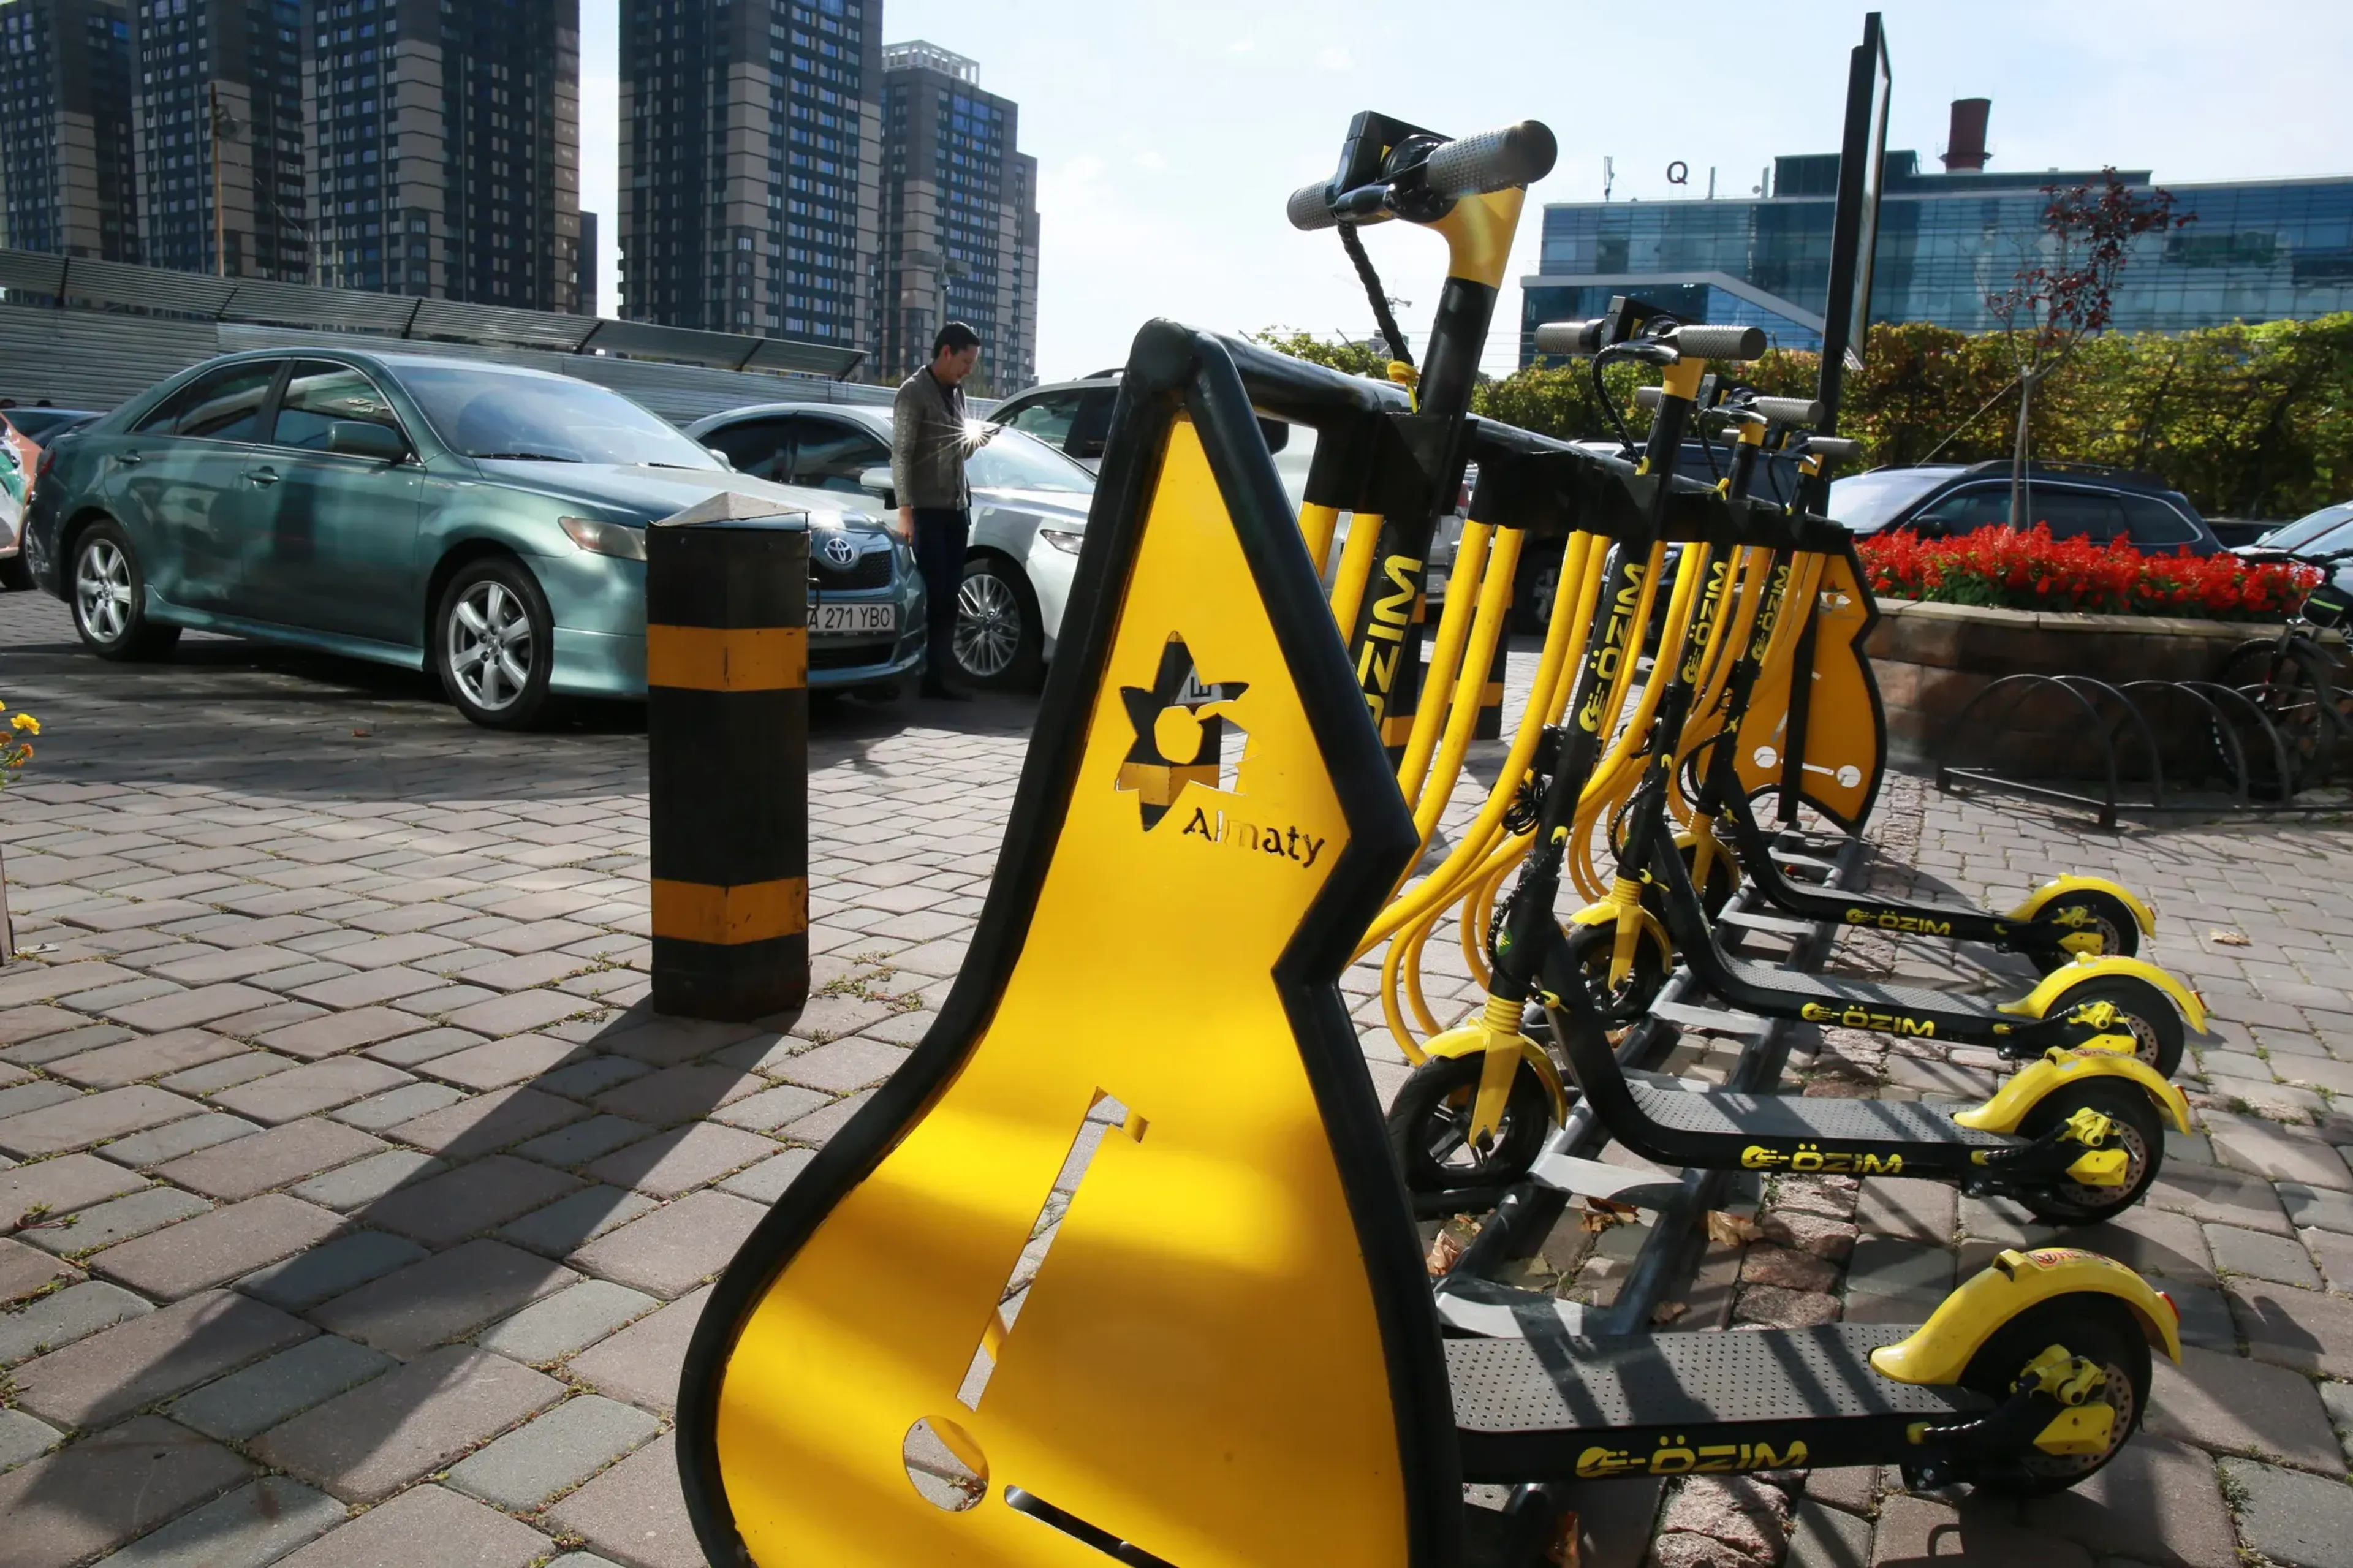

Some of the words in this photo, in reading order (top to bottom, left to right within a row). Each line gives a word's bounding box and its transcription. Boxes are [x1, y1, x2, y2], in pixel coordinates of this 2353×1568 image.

[1667, 161, 1688, 186] Q
[825, 607, 853, 629] 271
[859, 607, 891, 628] YBO
[1183, 806, 1325, 869] Almaty
[1877, 909, 1951, 936] ÖZIM
[1841, 1004, 1935, 1037] ÖZIM
[1790, 1143, 1904, 1174] ÖZIM
[1648, 1434, 1808, 1474] ÖZIM
